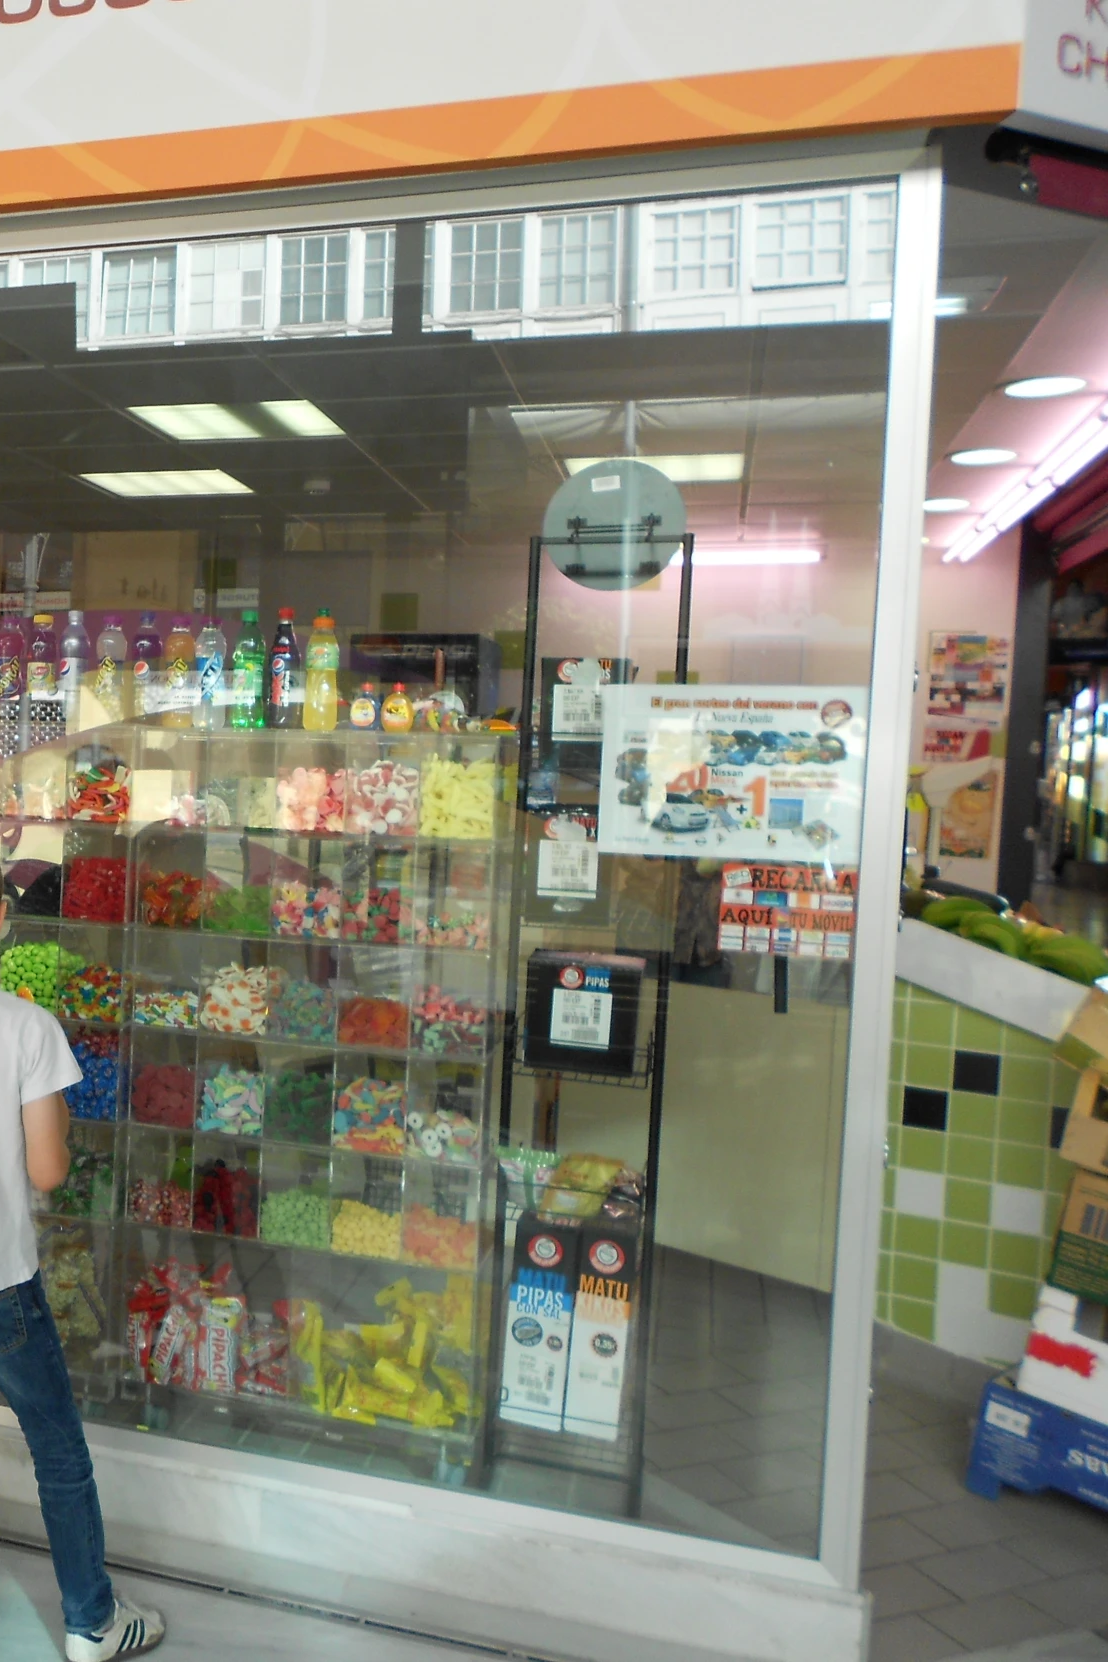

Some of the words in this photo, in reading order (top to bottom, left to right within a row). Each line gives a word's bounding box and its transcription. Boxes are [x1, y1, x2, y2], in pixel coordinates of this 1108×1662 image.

[711, 768, 744, 777] Nissan
[721, 906, 774, 926] AQUÍ
[585, 976, 610, 988] PIPAS
[516, 1284, 564, 1310] PIPAS
[579, 1273, 629, 1302] MATU
